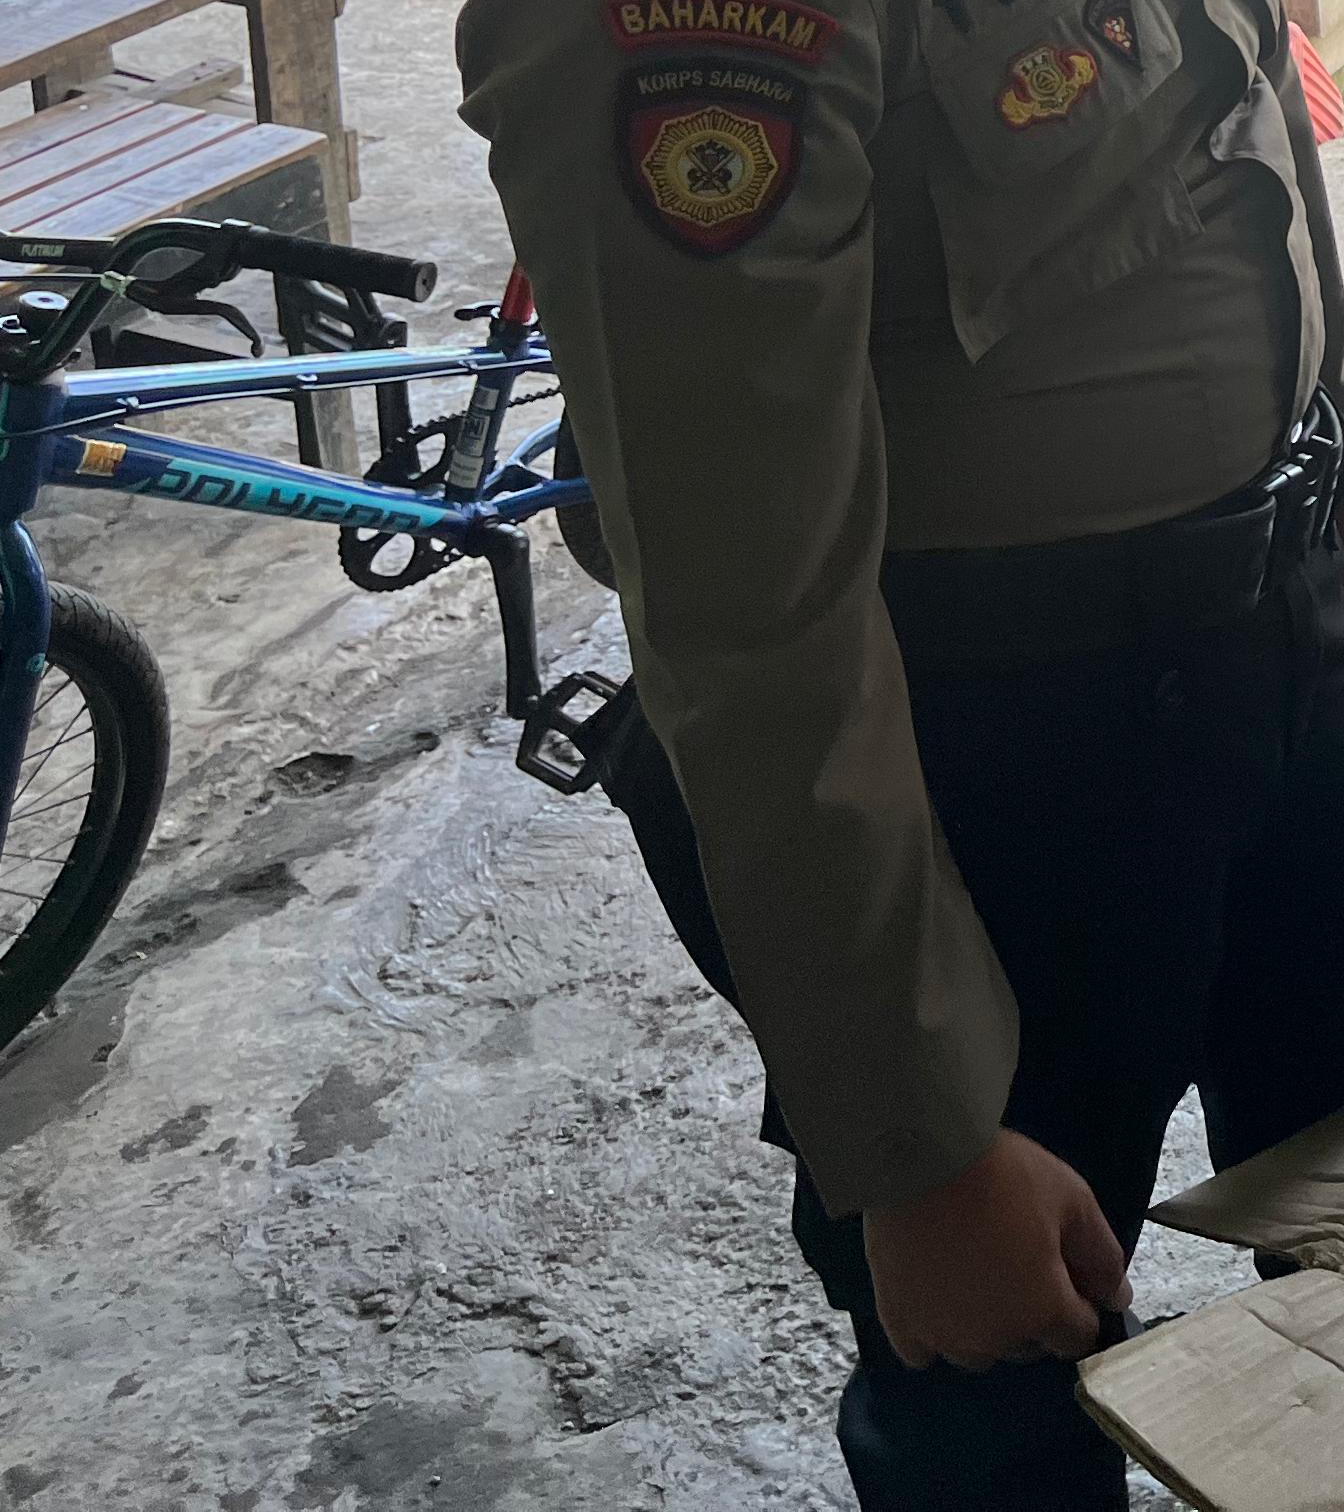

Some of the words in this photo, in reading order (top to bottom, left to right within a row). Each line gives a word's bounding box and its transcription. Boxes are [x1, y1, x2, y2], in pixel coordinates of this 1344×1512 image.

[637, 70, 704, 95] KORPS
[708, 71, 794, 103] SABHARA
[144, 467, 422, 530] POLYGON
